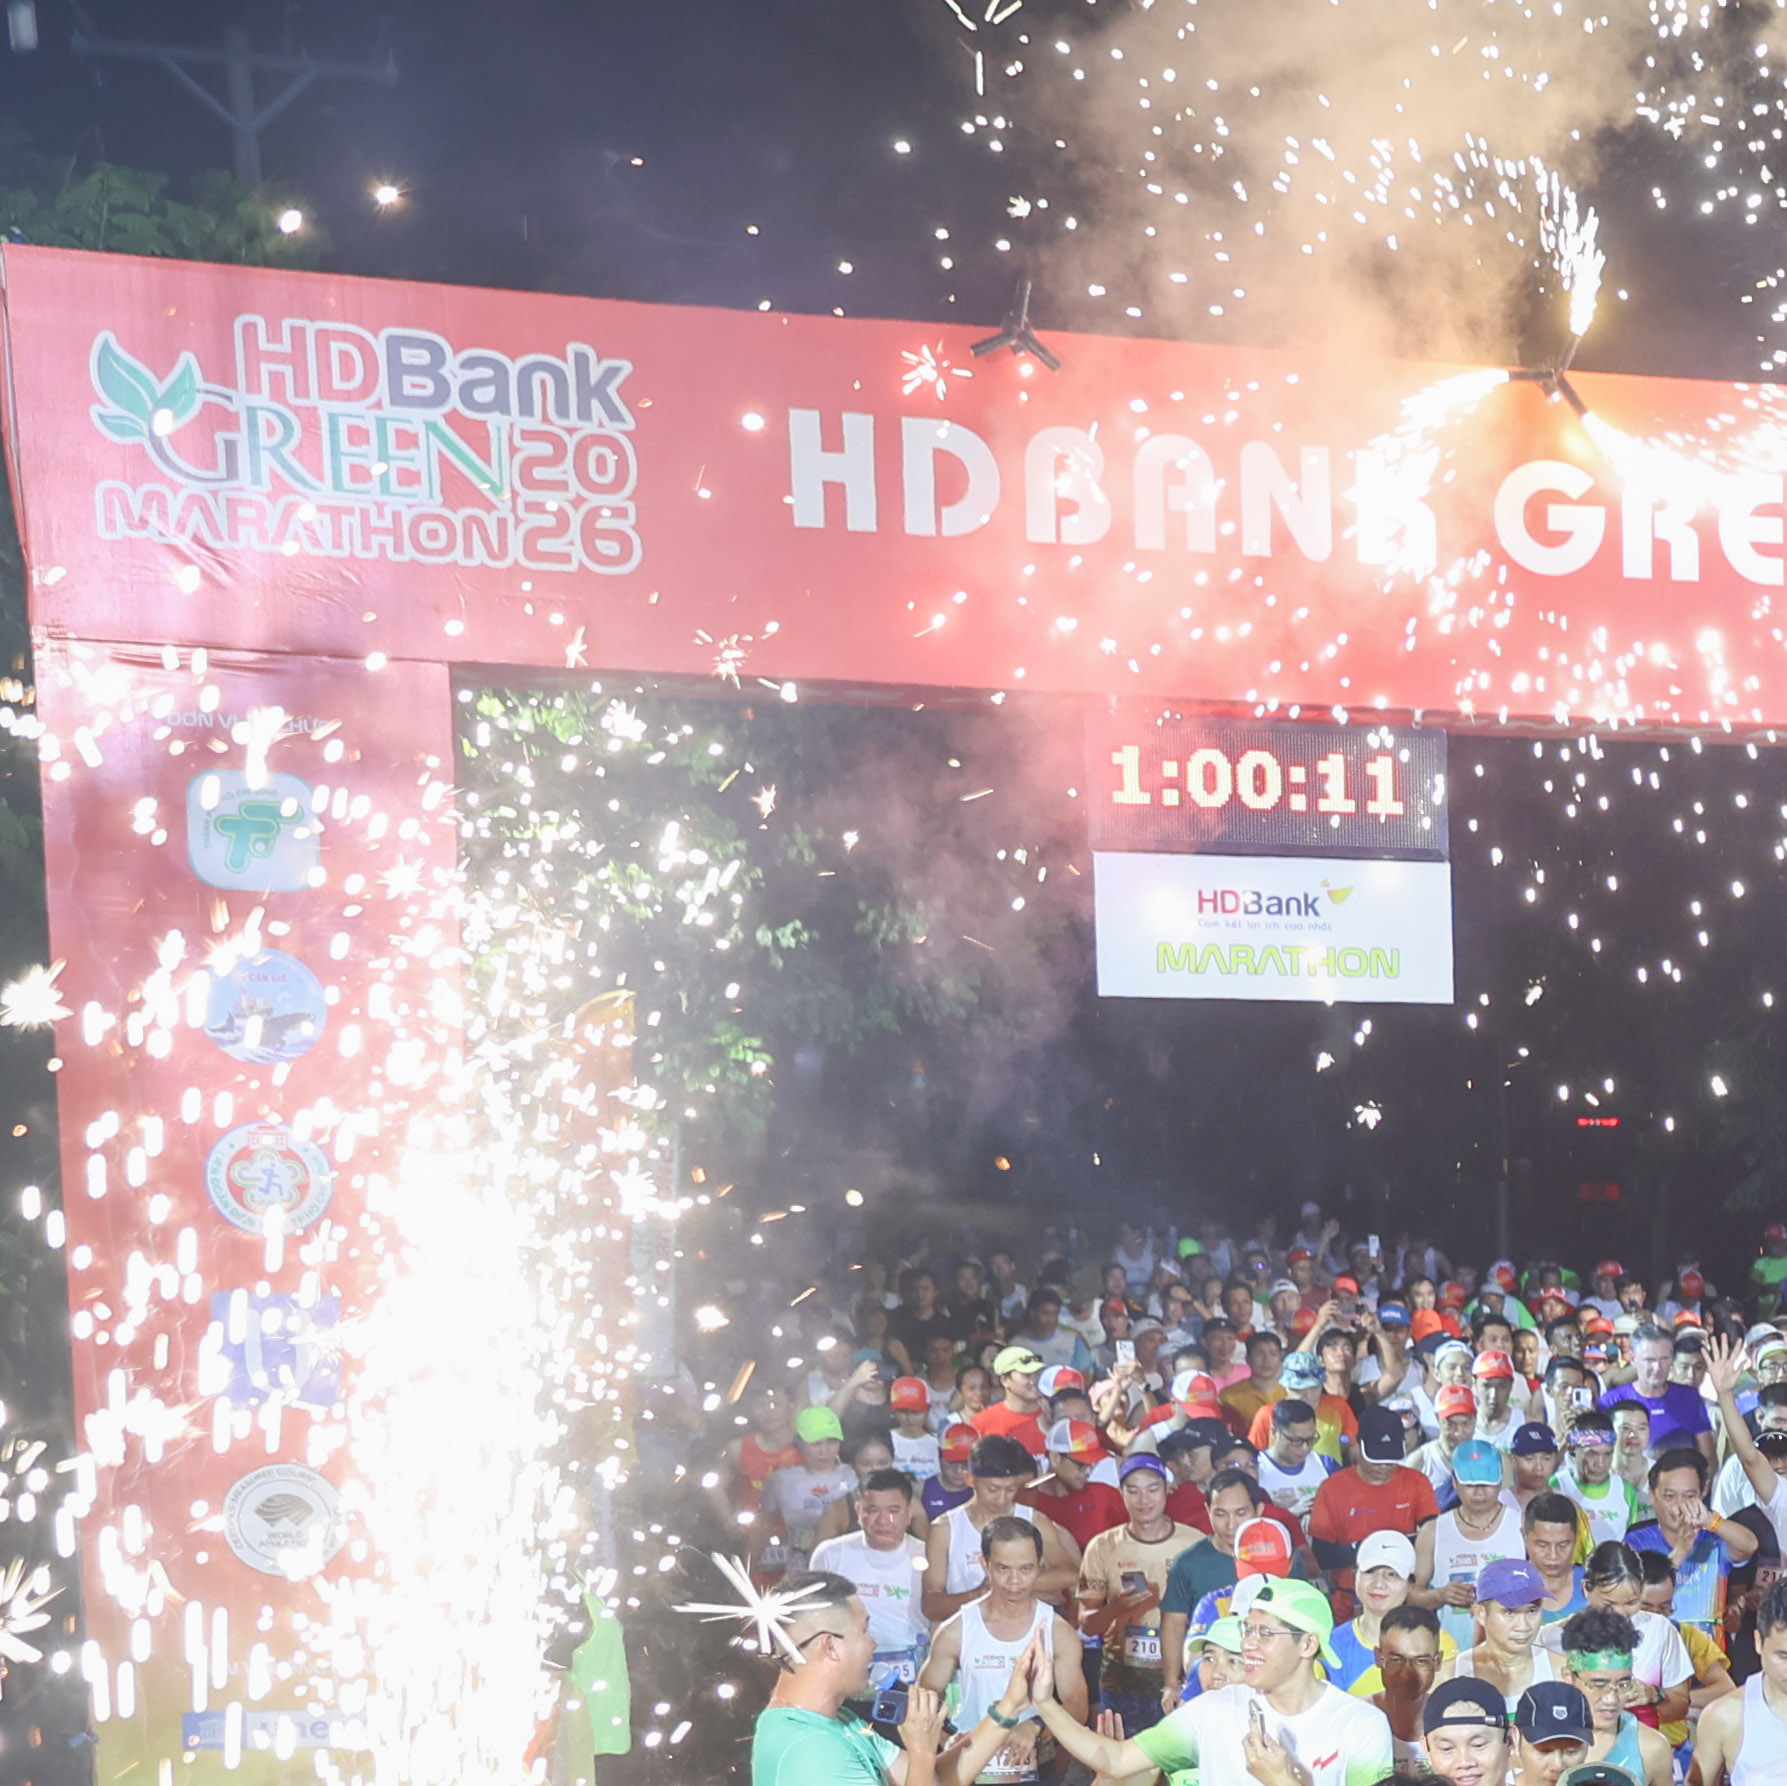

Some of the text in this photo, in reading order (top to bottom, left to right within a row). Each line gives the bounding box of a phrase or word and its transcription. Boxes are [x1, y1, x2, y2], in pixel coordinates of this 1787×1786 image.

[238, 316, 633, 428] HDBank
[148, 390, 633, 505] GREEN 20
[98, 484, 641, 574] MARATHON 26
[1111, 744, 1405, 816] 1:00:11
[1196, 888, 1321, 917] HDBank
[1156, 942, 1400, 979] MARATHON
[258, 1539, 309, 1549] ATHLETIC
